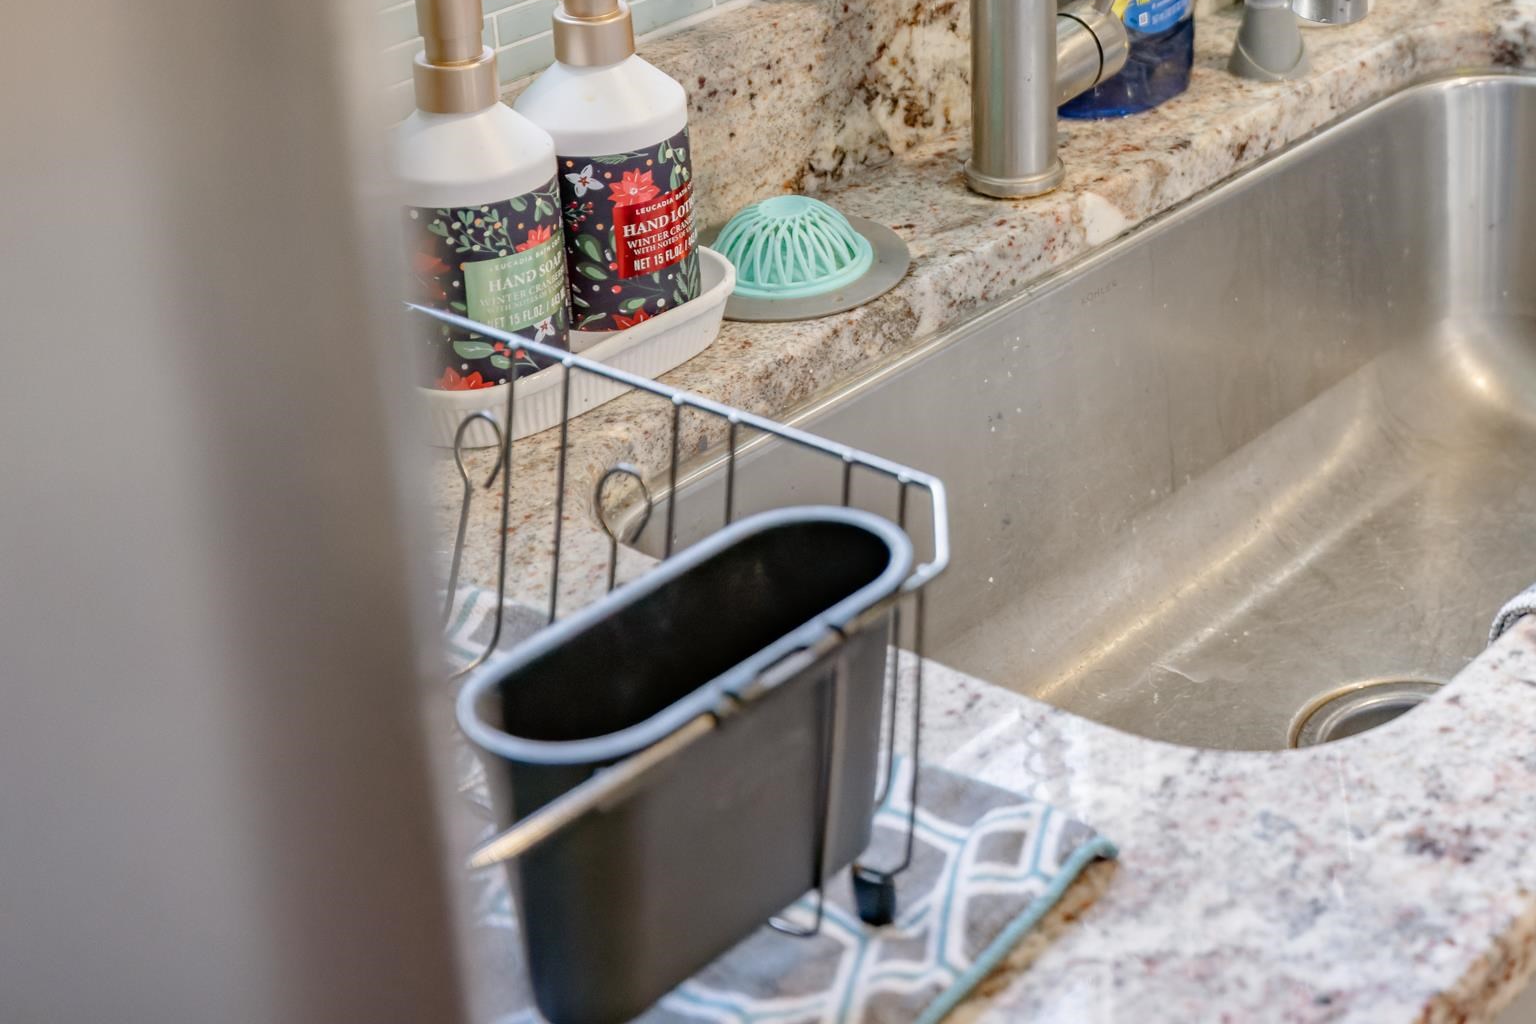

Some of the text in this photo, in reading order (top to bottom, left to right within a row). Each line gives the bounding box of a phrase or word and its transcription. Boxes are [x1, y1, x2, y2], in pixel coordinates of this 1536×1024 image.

[635, 197, 674, 216] LEUCADIA
[622, 214, 670, 238] HAND
[626, 229, 670, 250] WINTER
[633, 244, 656, 256] WITH
[657, 234, 679, 250] NOTES
[488, 269, 537, 293] HAND
[538, 250, 562, 278] SOAP
[633, 256, 651, 272] NET
[654, 252, 664, 267] 15
[479, 287, 526, 307] WINTER
[510, 314, 520, 326] 15
